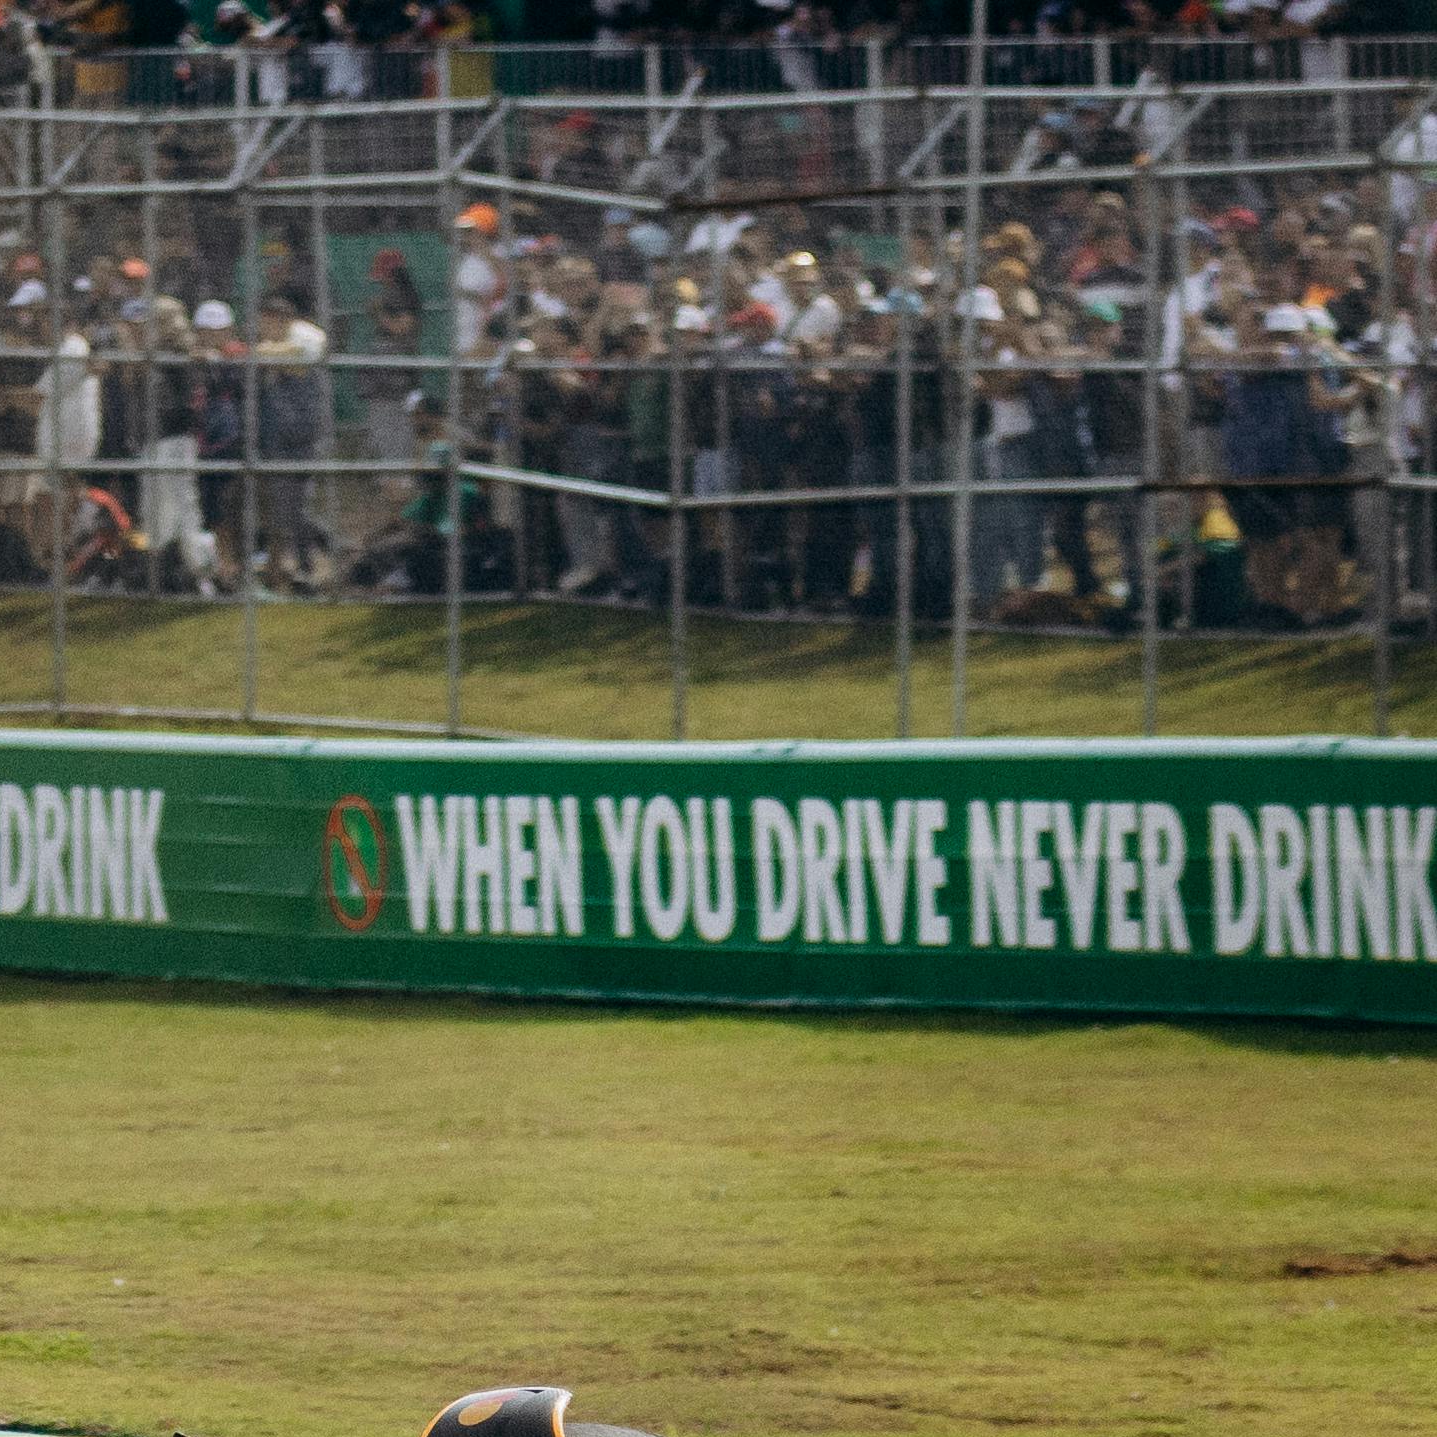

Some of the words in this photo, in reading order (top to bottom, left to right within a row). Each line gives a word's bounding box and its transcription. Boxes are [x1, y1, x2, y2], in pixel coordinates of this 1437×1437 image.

[395, 794, 585, 937] WHEN
[593, 796, 730, 943] YOU
[750, 797, 951, 948] DRIVE
[967, 801, 1191, 955] NEVER
[1210, 804, 1437, 961] DRINK
